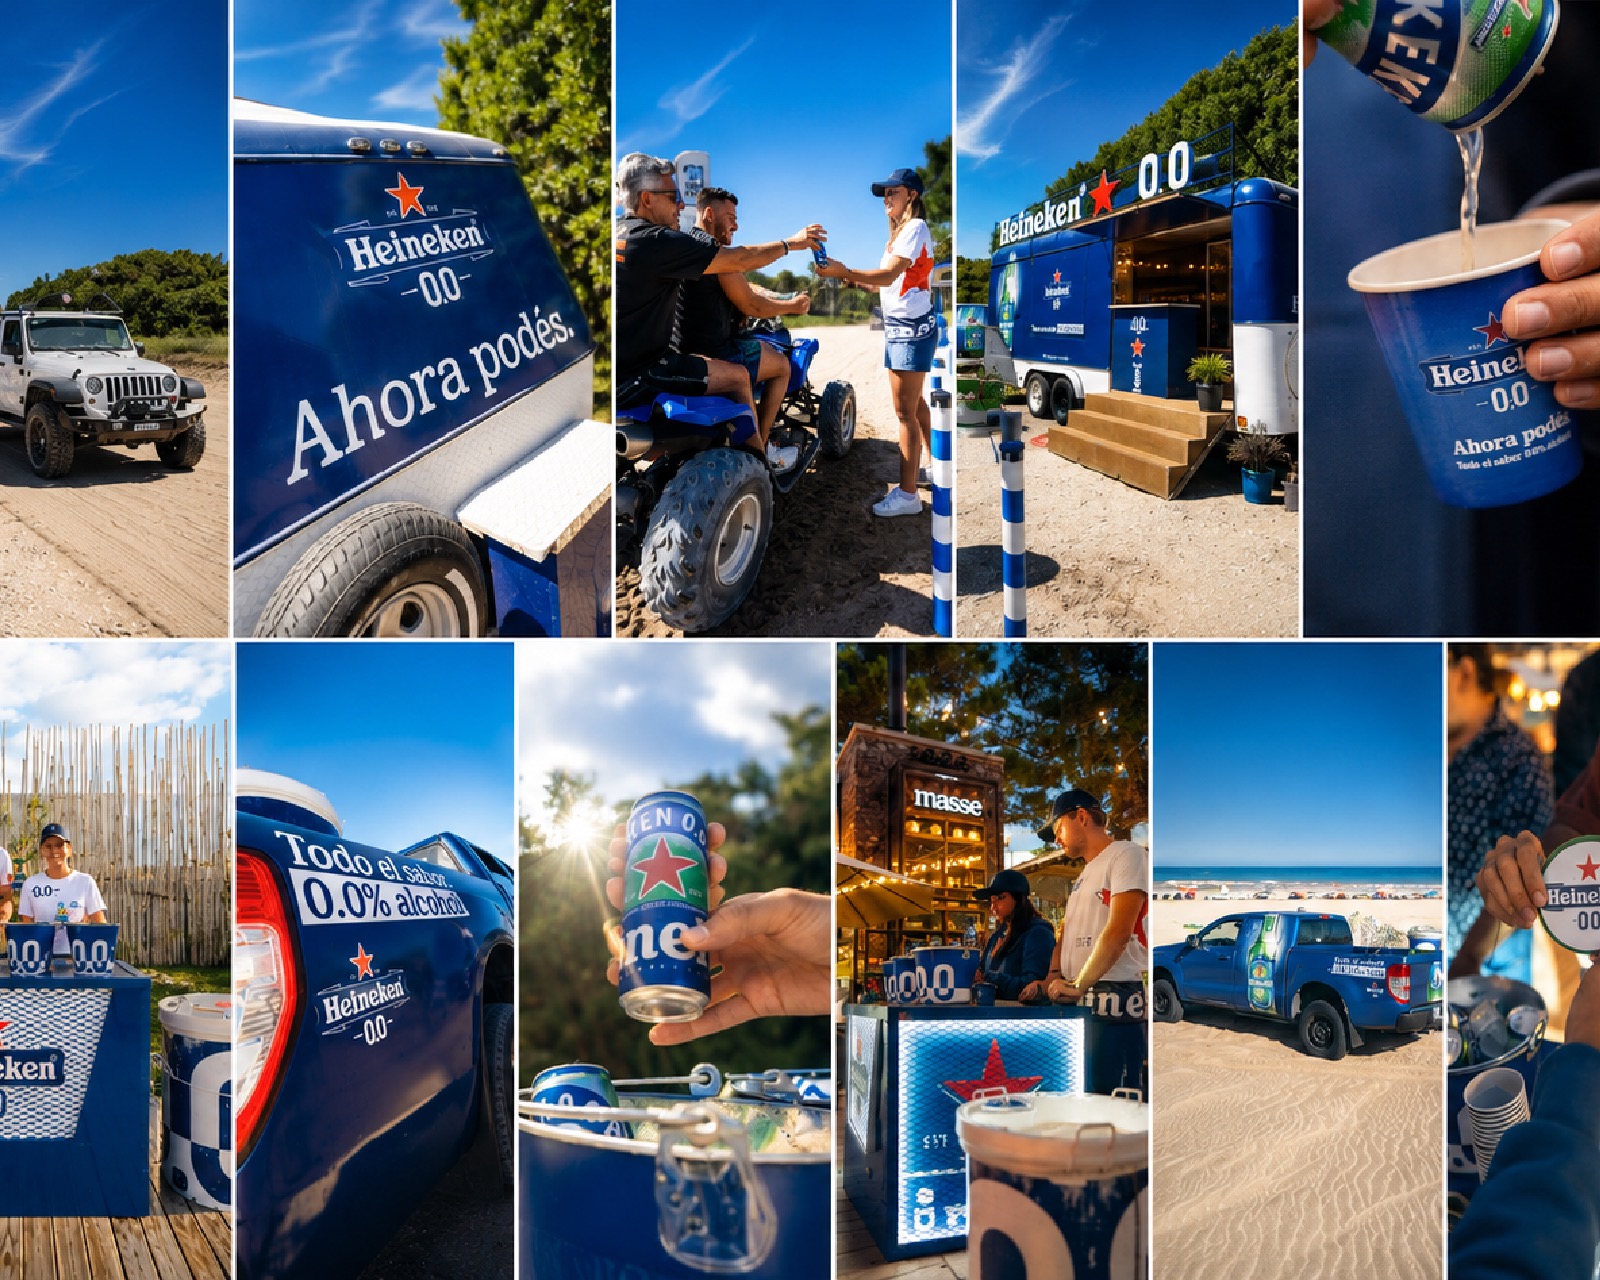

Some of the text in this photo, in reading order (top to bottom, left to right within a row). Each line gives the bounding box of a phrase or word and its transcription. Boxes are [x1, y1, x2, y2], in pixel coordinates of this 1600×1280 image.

[999, 196, 1083, 246] Heineken
[345, 223, 486, 271] Heineken
[287, 305, 575, 486] Ahora podés.
[1453, 434, 1518, 456] Ahora
[914, 788, 983, 817] masse
[274, 831, 374, 877] Todo
[378, 856, 403, 881] el
[302, 877, 392, 920] 0.0%
[1547, 887, 1600, 905] Heine
[323, 979, 405, 1025] Heineken
